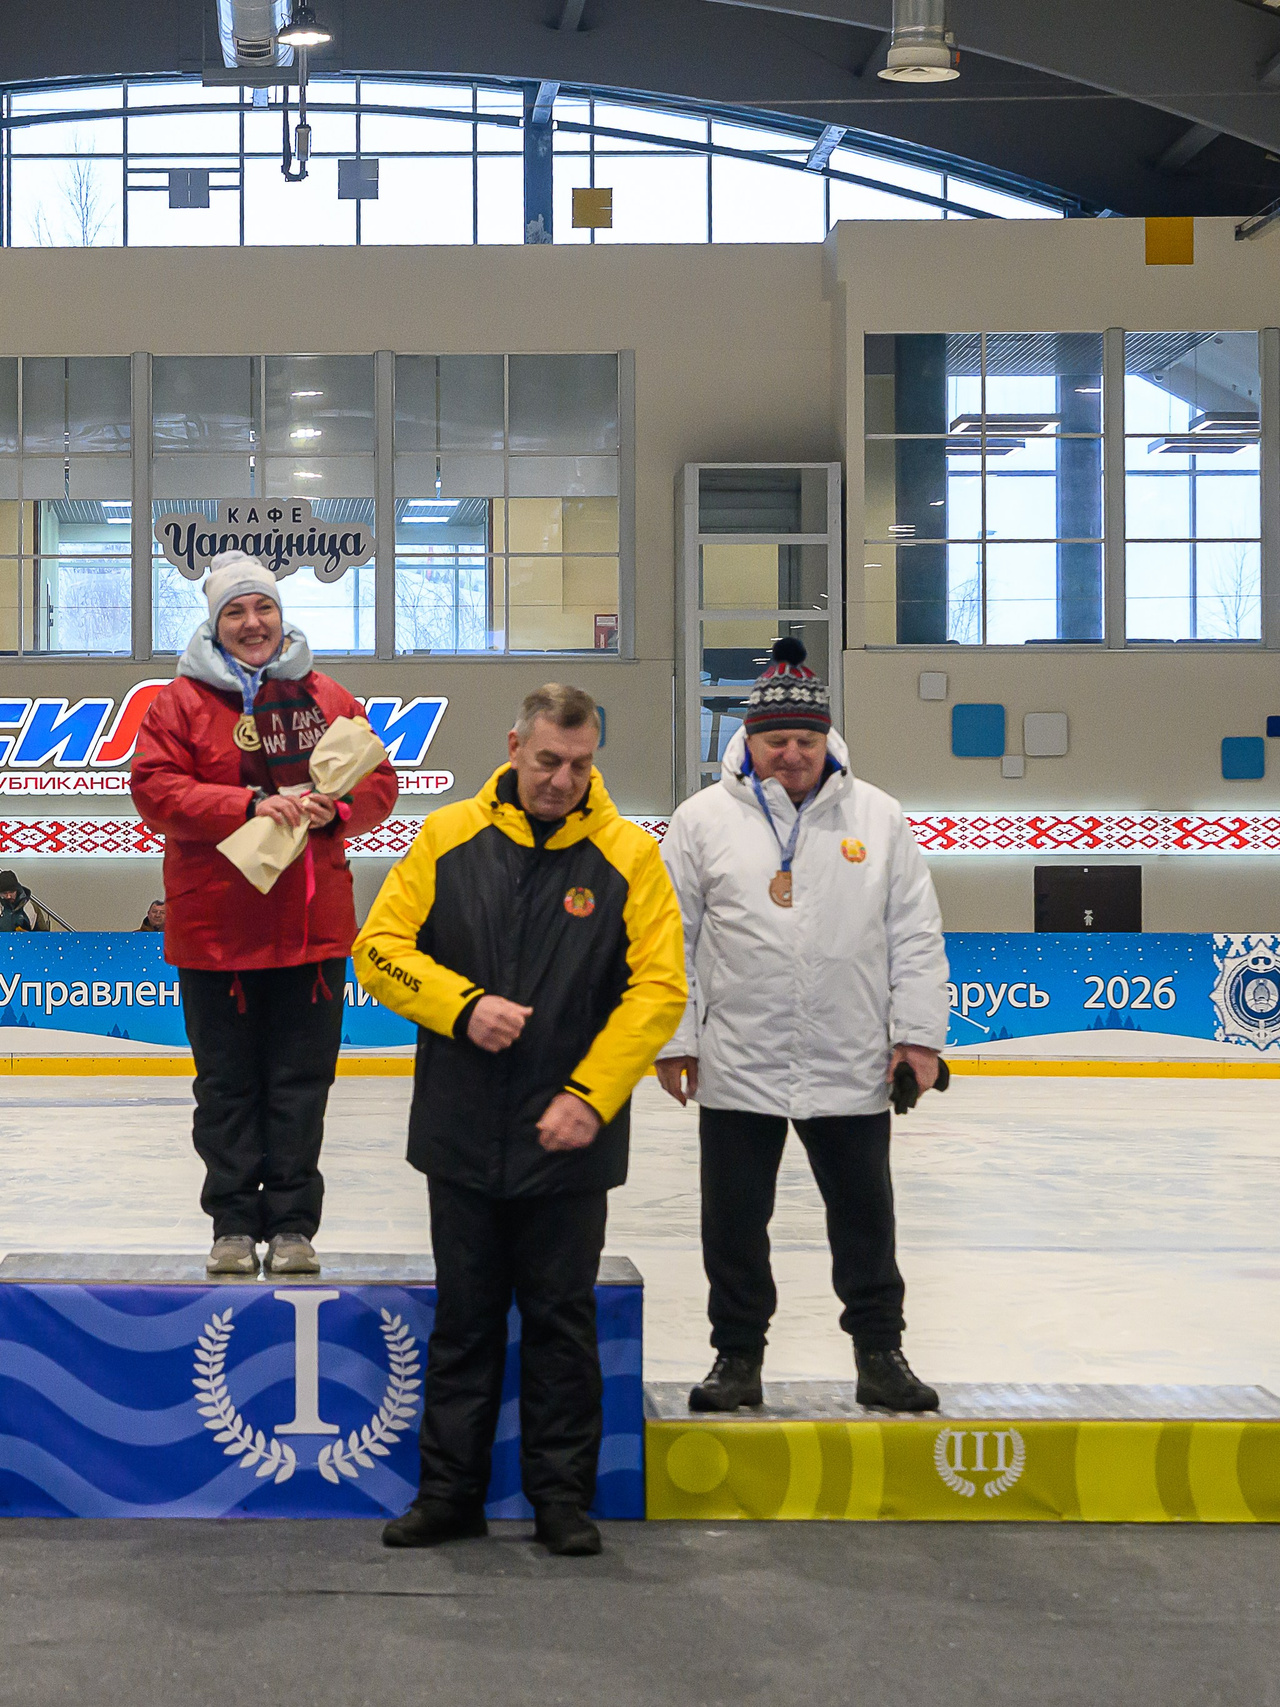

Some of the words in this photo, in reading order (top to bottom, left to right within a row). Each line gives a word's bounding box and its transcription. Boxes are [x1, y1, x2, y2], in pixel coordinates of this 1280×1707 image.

[227, 507, 302, 524] КАФЕ
[164, 522, 367, 574] Чараўніца
[945, 982, 1051, 1017] арусь
[1083, 975, 1177, 1010] 2026
